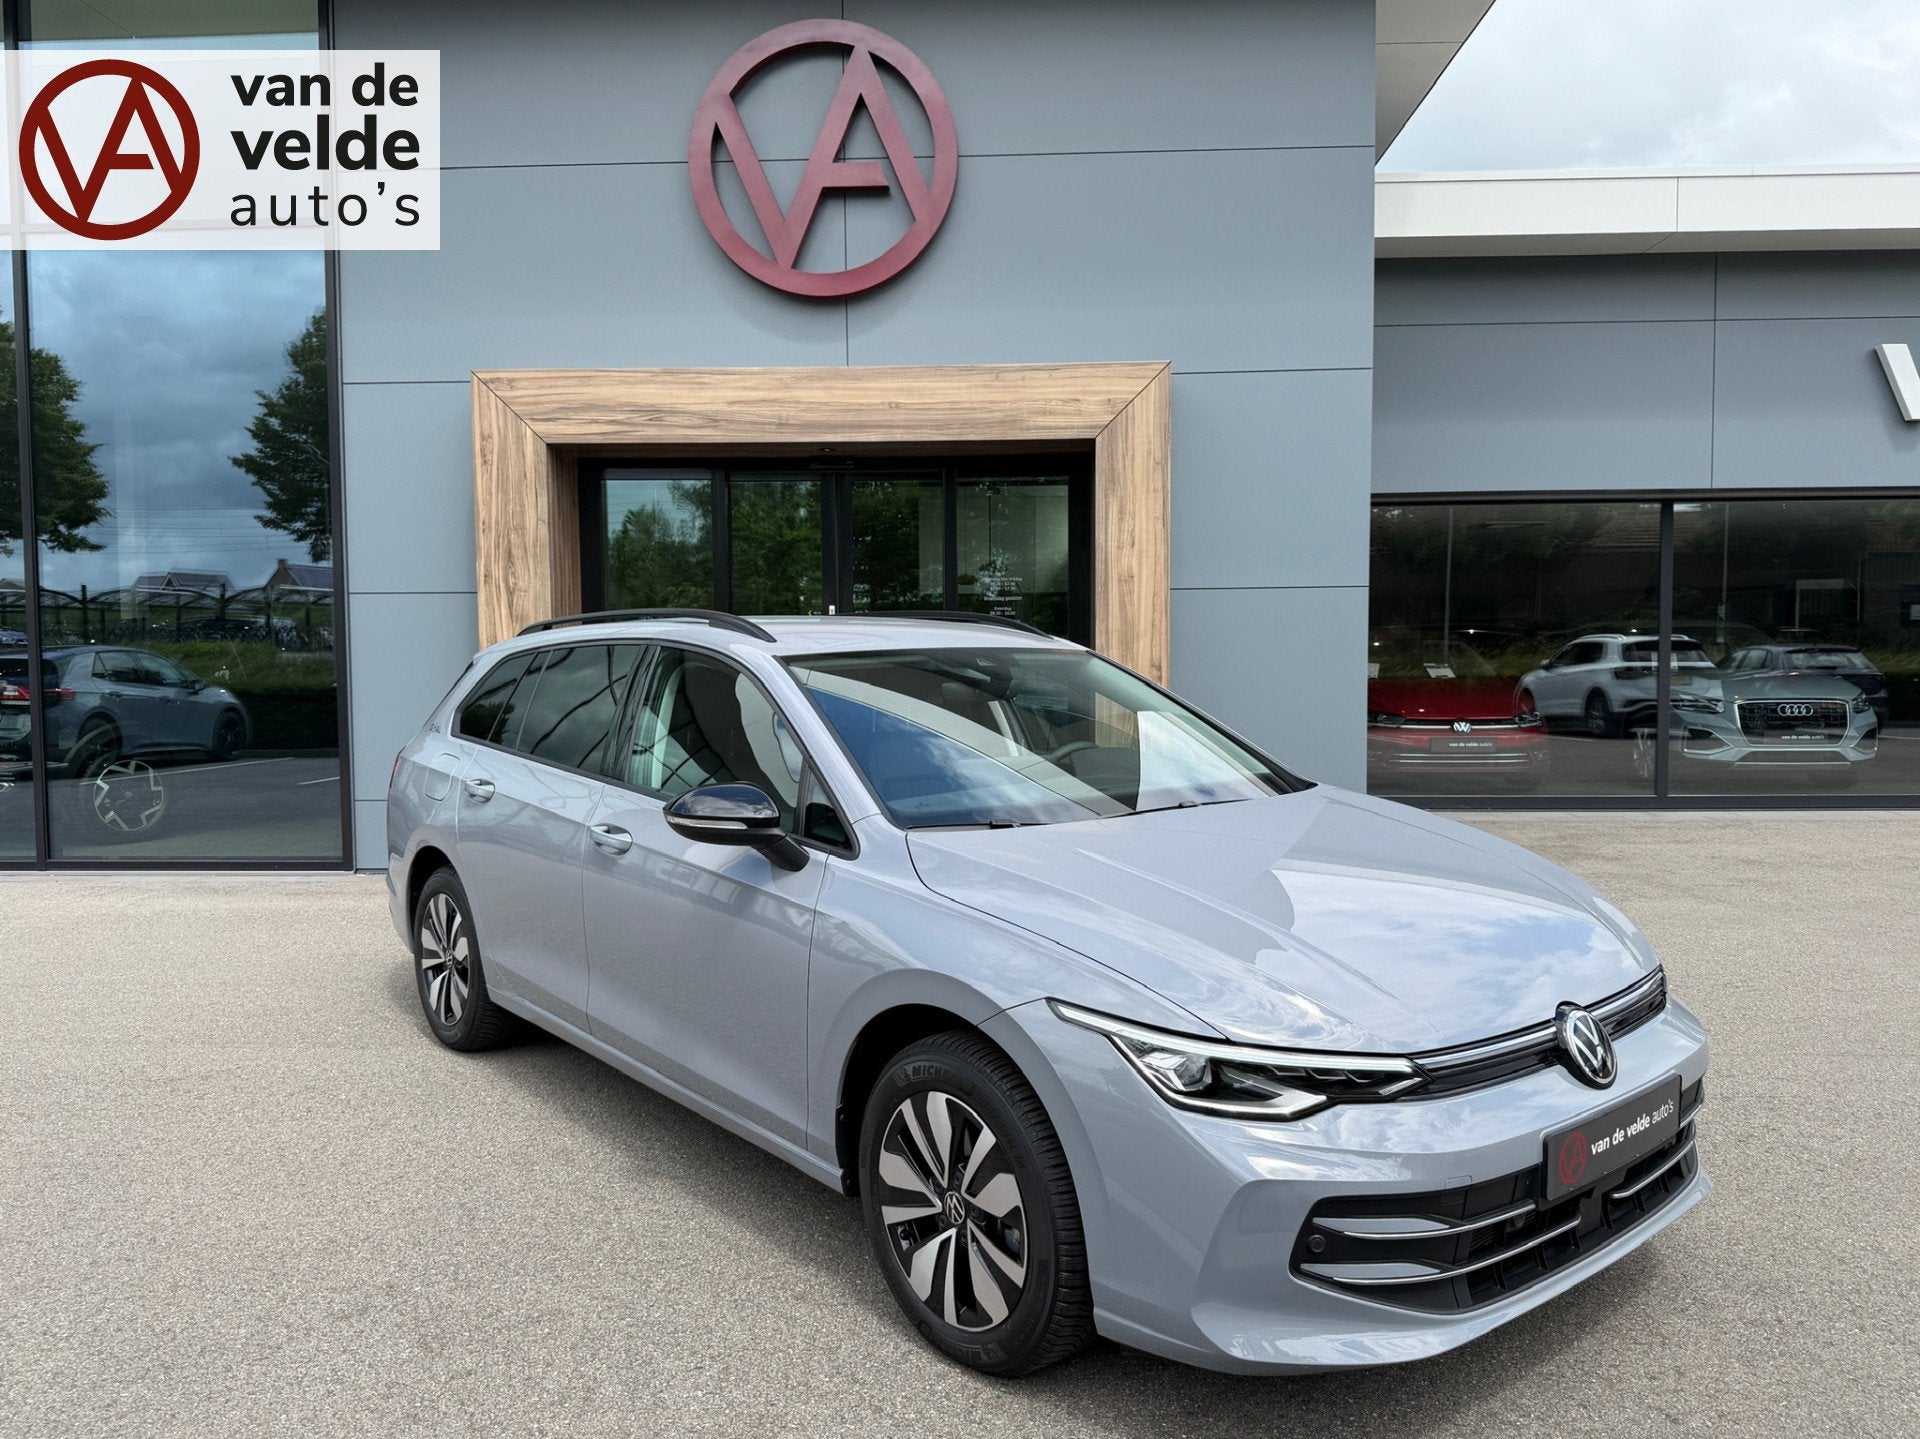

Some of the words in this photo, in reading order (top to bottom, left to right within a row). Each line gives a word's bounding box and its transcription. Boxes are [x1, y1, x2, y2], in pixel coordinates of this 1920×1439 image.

[1591, 1137, 1610, 1155] van
[1612, 1127, 1625, 1145] de
[1626, 1113, 1650, 1138] velde
[1651, 1099, 1674, 1124] auto's
